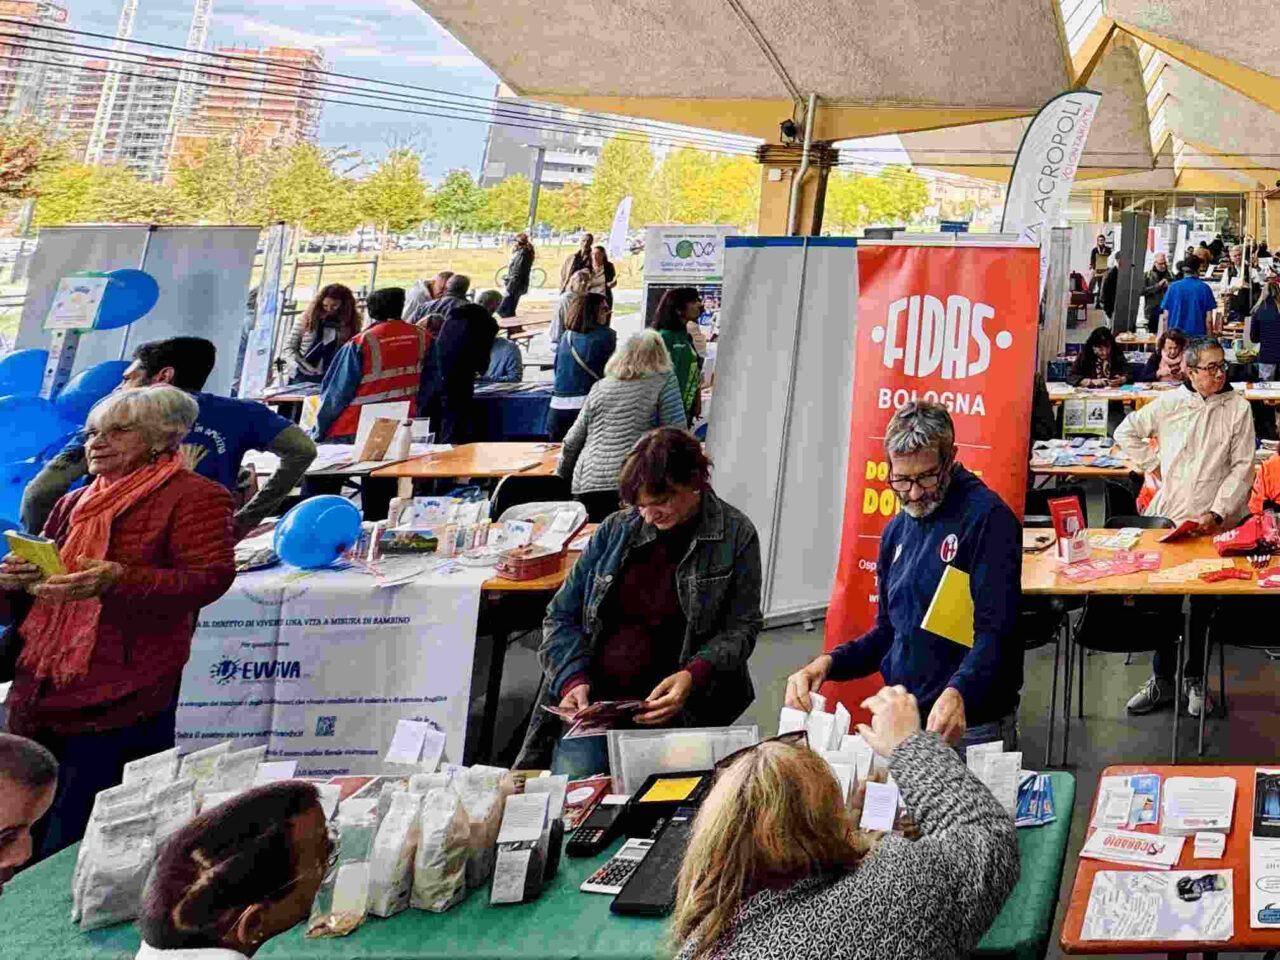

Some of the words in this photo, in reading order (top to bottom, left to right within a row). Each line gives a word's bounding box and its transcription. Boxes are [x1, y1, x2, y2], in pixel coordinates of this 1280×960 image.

[1034, 99, 1082, 214] ACROPOLI
[883, 294, 995, 379] FIDAS
[878, 388, 985, 417] BOLOGNA
